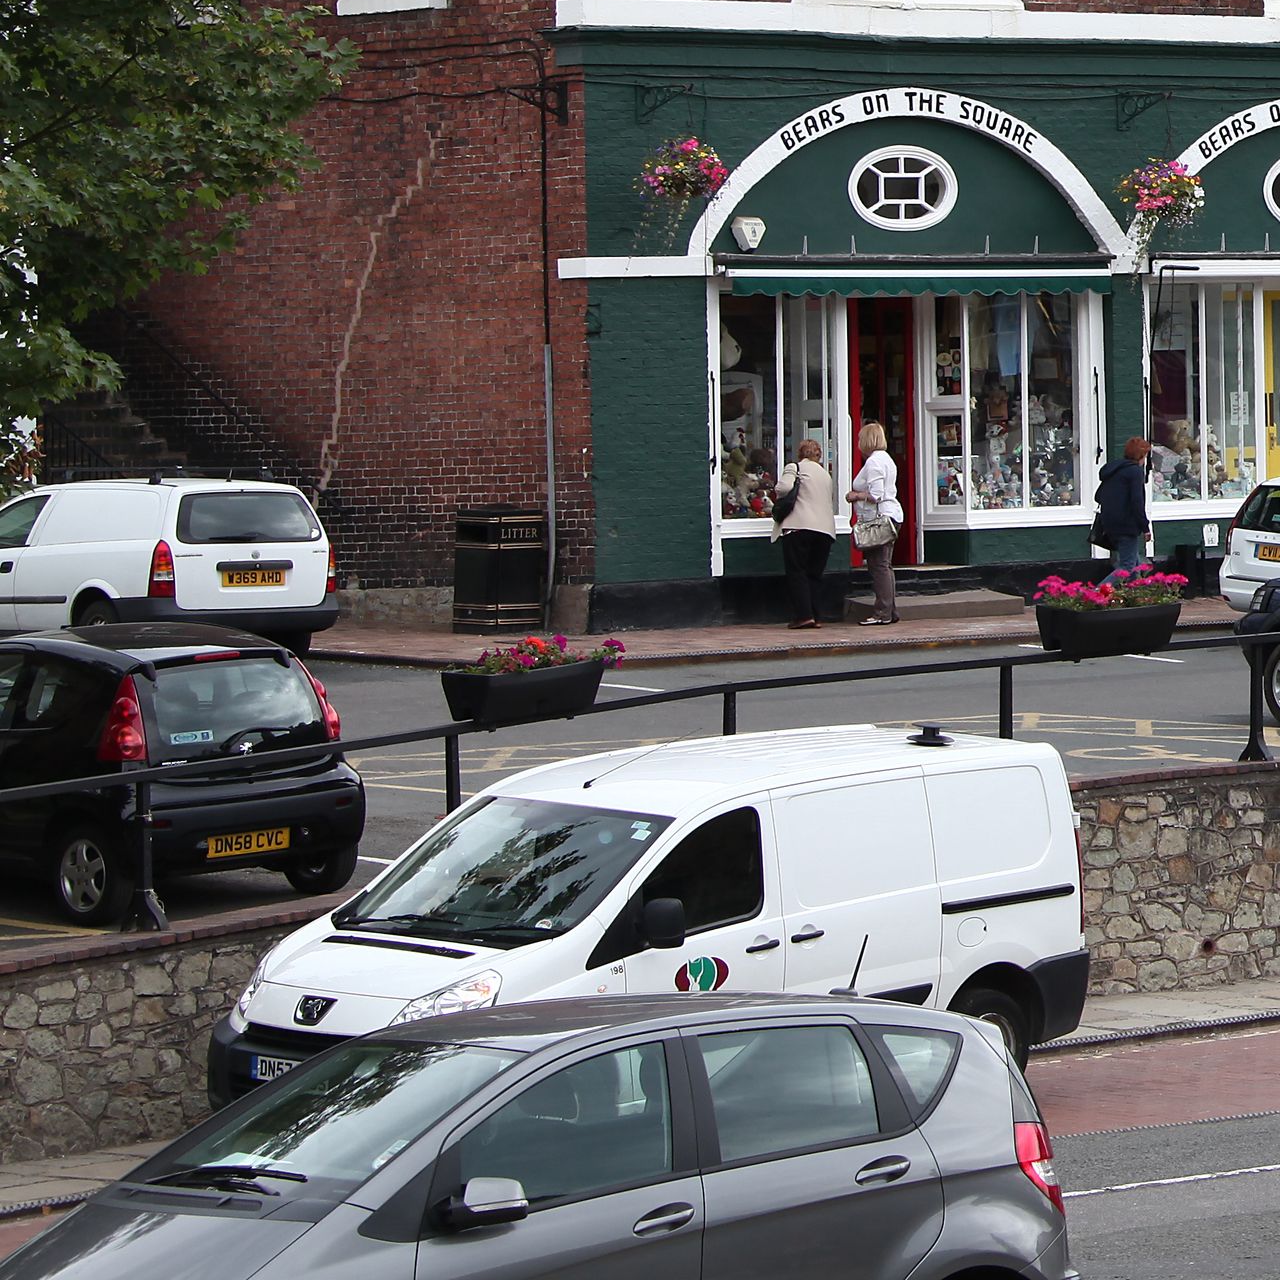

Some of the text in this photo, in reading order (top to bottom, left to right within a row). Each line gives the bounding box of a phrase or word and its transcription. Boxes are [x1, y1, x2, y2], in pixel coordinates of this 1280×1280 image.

[780, 104, 844, 151] BEARS
[905, 92, 947, 114] THE
[959, 101, 1038, 153] SQUARE
[1198, 112, 1256, 160] BEARS
[501, 527, 538, 539] LITTER
[227, 571, 282, 584] W369 AHD
[214, 830, 284, 854] DN58 CVC
[610, 964, 624, 976] 198
